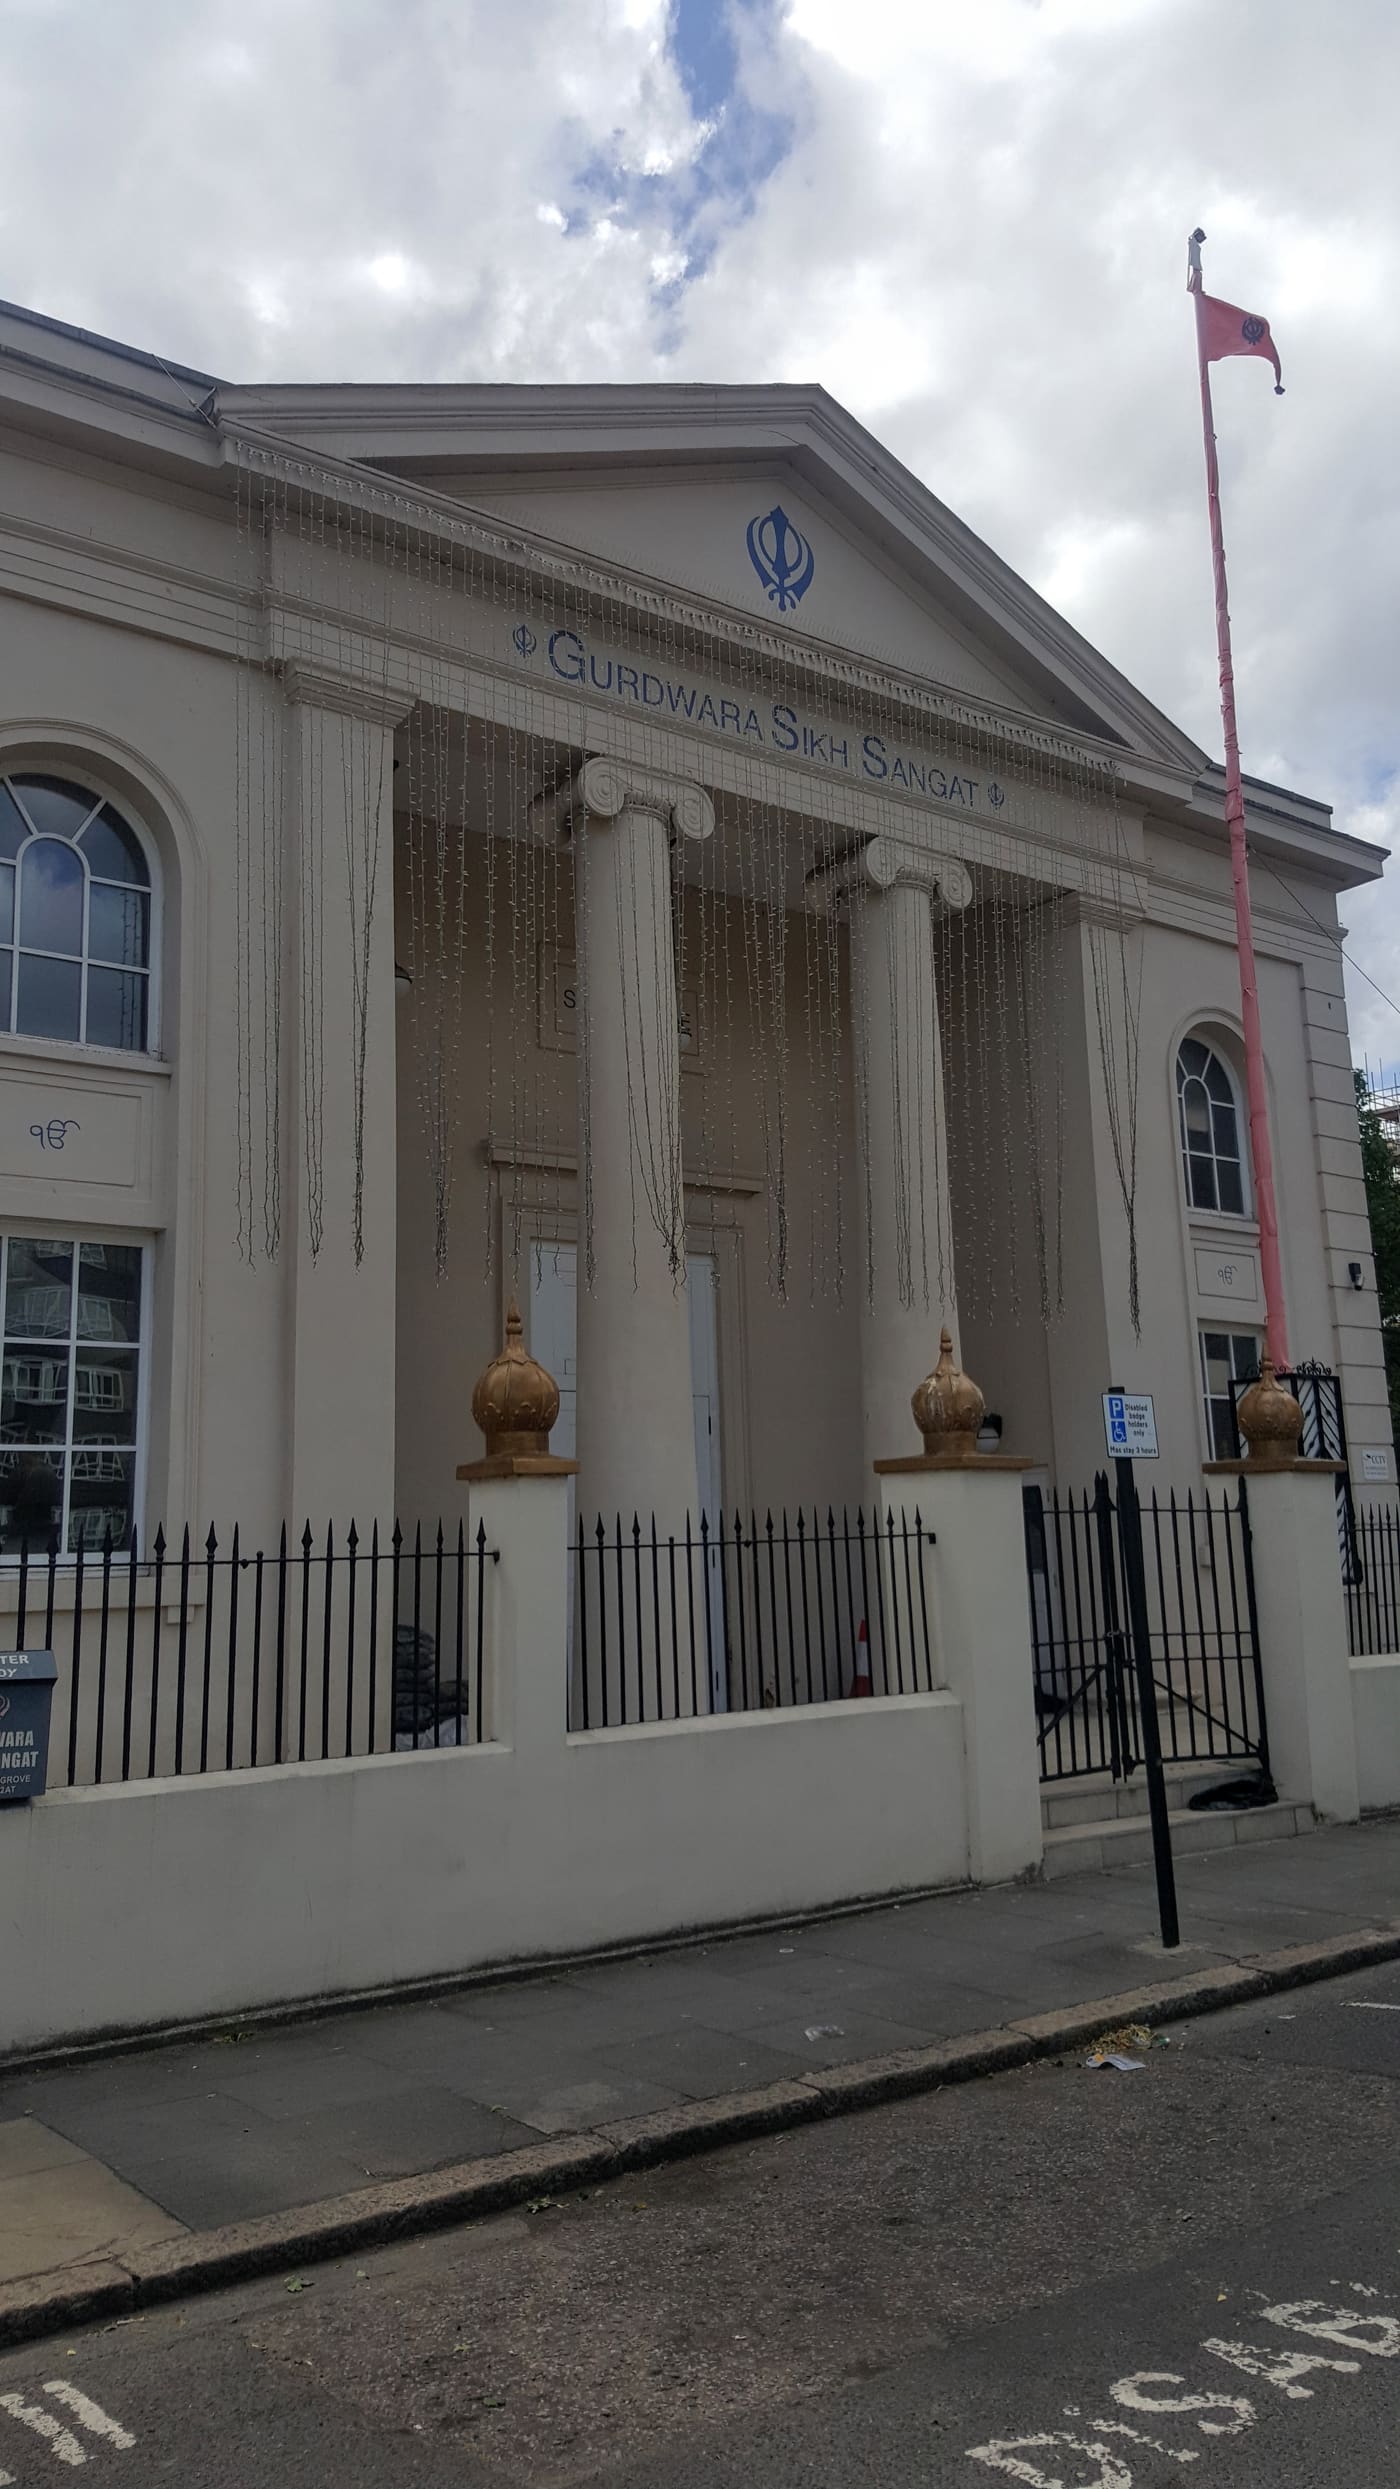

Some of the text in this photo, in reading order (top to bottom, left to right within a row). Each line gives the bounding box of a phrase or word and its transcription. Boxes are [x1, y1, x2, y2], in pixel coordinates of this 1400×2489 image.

[548, 629, 979, 807] GURDWARA SIKH SANGAT
[1125, 1403, 1148, 1411] Disabled
